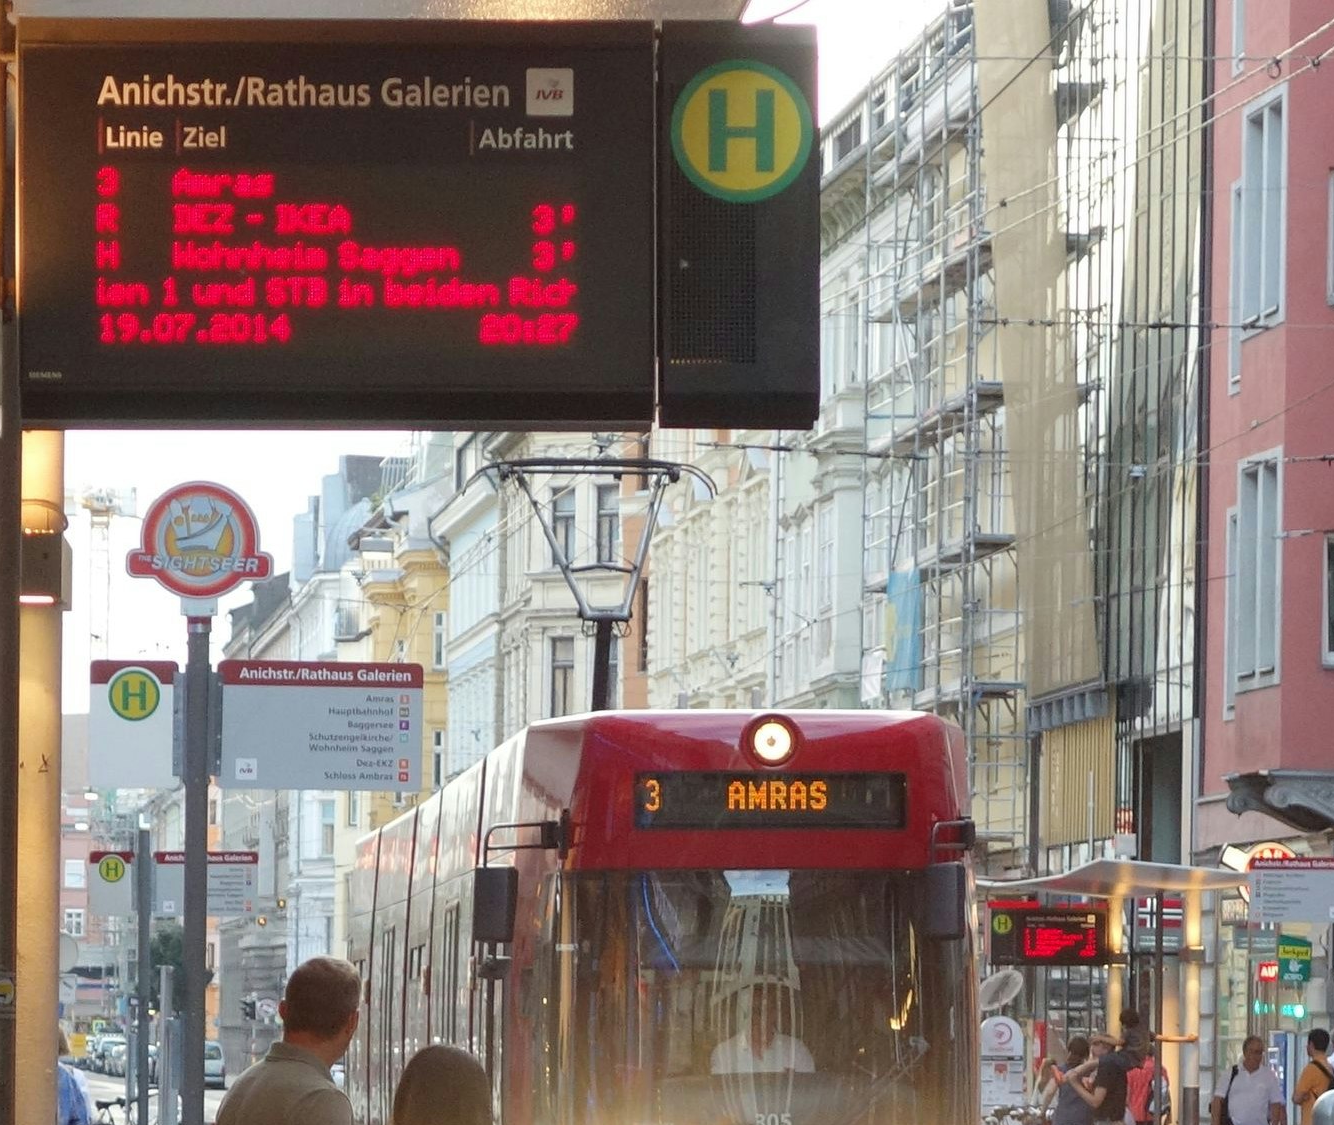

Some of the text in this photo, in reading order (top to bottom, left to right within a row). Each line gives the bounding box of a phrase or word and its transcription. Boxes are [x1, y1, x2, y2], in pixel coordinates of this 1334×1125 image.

[97, 75, 510, 107] Anichstr./Rathaus Galerien
[105, 126, 164, 148] Linie
[182, 126, 227, 148] Ziel
[479, 127, 574, 149] Abfahrt
[708, 88, 775, 172] H
[96, 165, 275, 198] 3 Amras
[96, 203, 120, 233] R
[275, 203, 353, 234] IKEA
[96, 240, 120, 270] H
[172, 240, 329, 271] Wohnheim
[338, 240, 461, 277] Saggen
[162, 276, 179, 307] 1
[193, 276, 256, 307] und
[267, 276, 329, 307] STB
[338, 278, 374, 307] in
[384, 277, 501, 307] beiden
[99, 312, 579, 344] 19.07.2014 20:27
[152, 555, 259, 573] SIGHTSEER
[239, 666, 412, 682] Anichstr./Rathaus Galerien
[122, 680, 147, 711] H
[366, 694, 395, 703] Amras
[328, 706, 395, 717] Hauptbahnhof
[347, 720, 395, 731] Baggersee
[324, 771, 357, 780] Schloss
[359, 772, 394, 781] Ambras
[644, 779, 828, 812] 3 AMRAS
